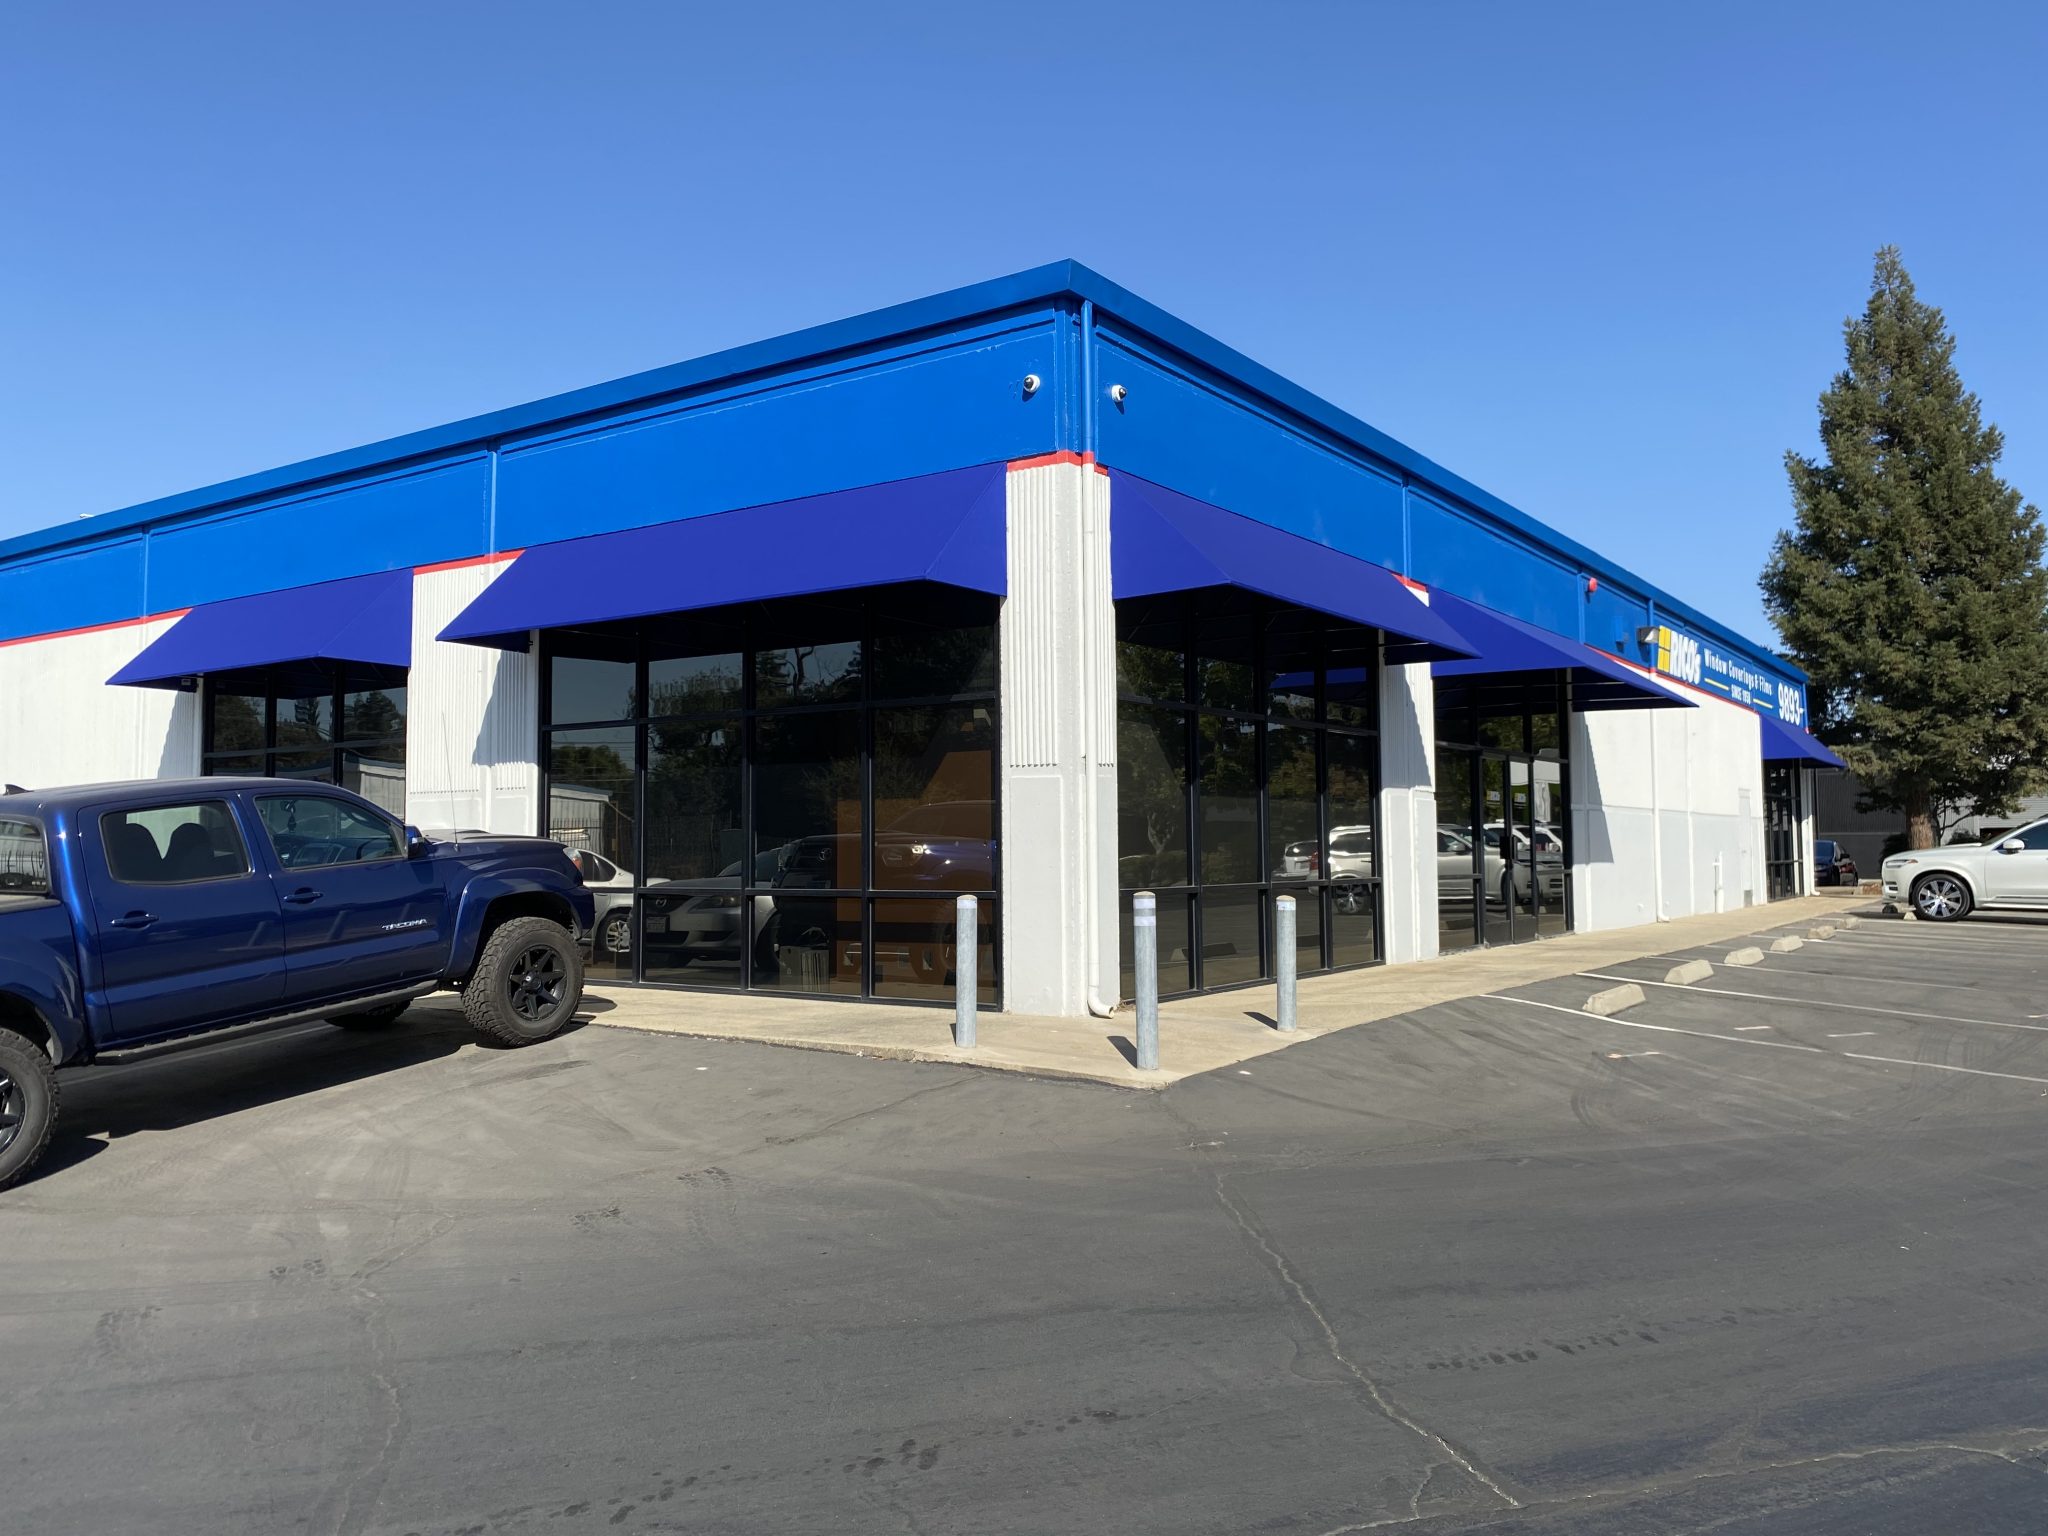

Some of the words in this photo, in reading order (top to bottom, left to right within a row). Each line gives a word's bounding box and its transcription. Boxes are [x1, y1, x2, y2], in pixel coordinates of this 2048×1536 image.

[1704, 648, 1727, 674] Window
[1729, 660, 1754, 690] Coverings
[1759, 676, 1772, 696] Films
[382, 918, 427, 930] TACOMA
